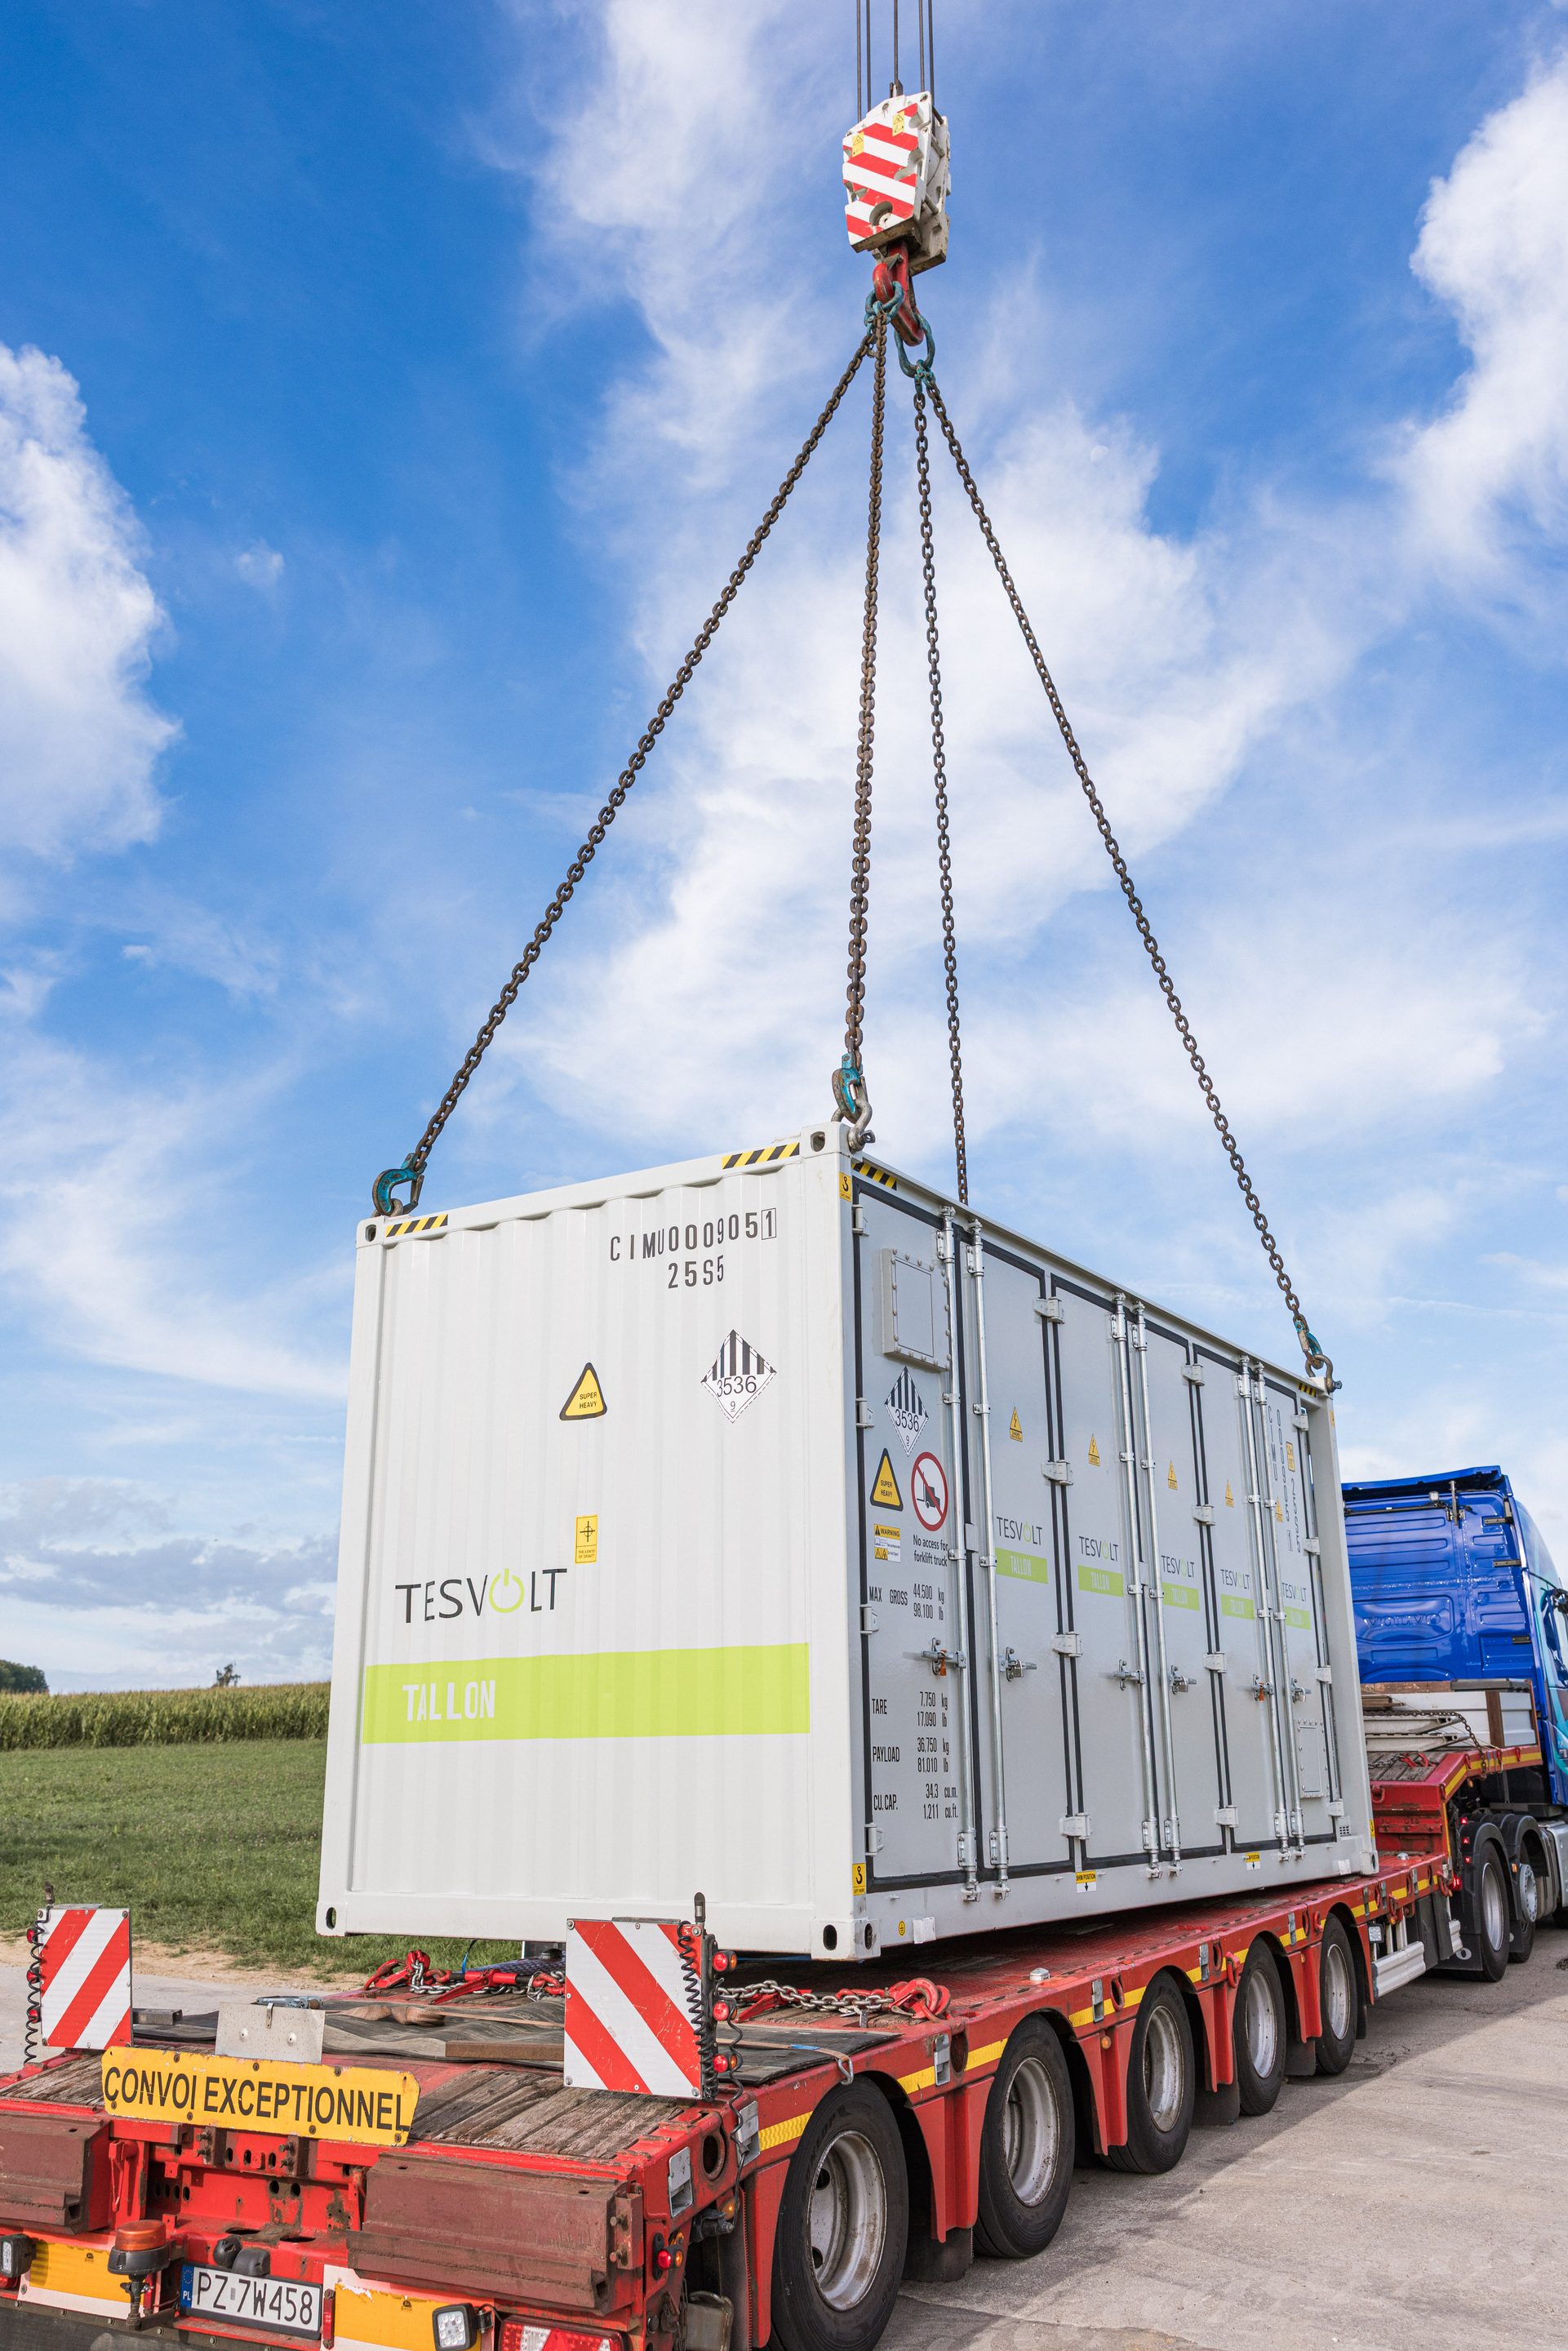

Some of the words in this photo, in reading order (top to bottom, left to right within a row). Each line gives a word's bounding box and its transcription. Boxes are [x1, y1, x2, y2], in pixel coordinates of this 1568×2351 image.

[668, 1255, 725, 1289] 25S5
[580, 1392, 597, 1400] SUPER
[717, 1375, 757, 1398] 3536
[580, 1401, 597, 1409] HEAVY
[730, 1401, 736, 1411] 9
[895, 1409, 920, 1433] 3536
[880, 1480, 892, 1488] SUPER
[880, 1490, 892, 1498] HEAVY
[881, 1528, 900, 1537] WARNING
[997, 1517, 1042, 1545] TESVOLT
[913, 1535, 921, 1546] No
[922, 1539, 939, 1550] access
[940, 1540, 948, 1550] for
[1079, 1536, 1118, 1562] TESVOLT
[914, 1550, 933, 1564] forklift
[934, 1556, 948, 1567] truck
[1011, 1555, 1033, 1577] TALLON
[1161, 1555, 1195, 1579] TESVOLT
[1220, 1569, 1250, 1590] TESVOLT
[395, 1568, 567, 1624] TESVOLT
[869, 1586, 882, 1602] MAX
[890, 1589, 908, 1606] GROSS
[938, 1588, 944, 1605] kg
[1281, 1582, 1307, 1602] TESVOLT
[939, 1607, 944, 1620] lb
[1363, 1611, 1442, 1629] VOLVO
[402, 1679, 496, 1722] TALLON
[872, 1699, 887, 1714] TARE
[941, 1693, 948, 1710] kg
[942, 1713, 948, 1727] lb
[873, 1747, 900, 1762] PAYLOAD
[942, 1738, 949, 1755] kg
[943, 1758, 948, 1772] lb
[104, 2066, 198, 2112] CONVOI
[203, 2077, 411, 2131] EXCEPTIONNEL
[183, 2291, 192, 2301] PL
[197, 2271, 229, 2310] PZ
[237, 2278, 313, 2325] 7W458
